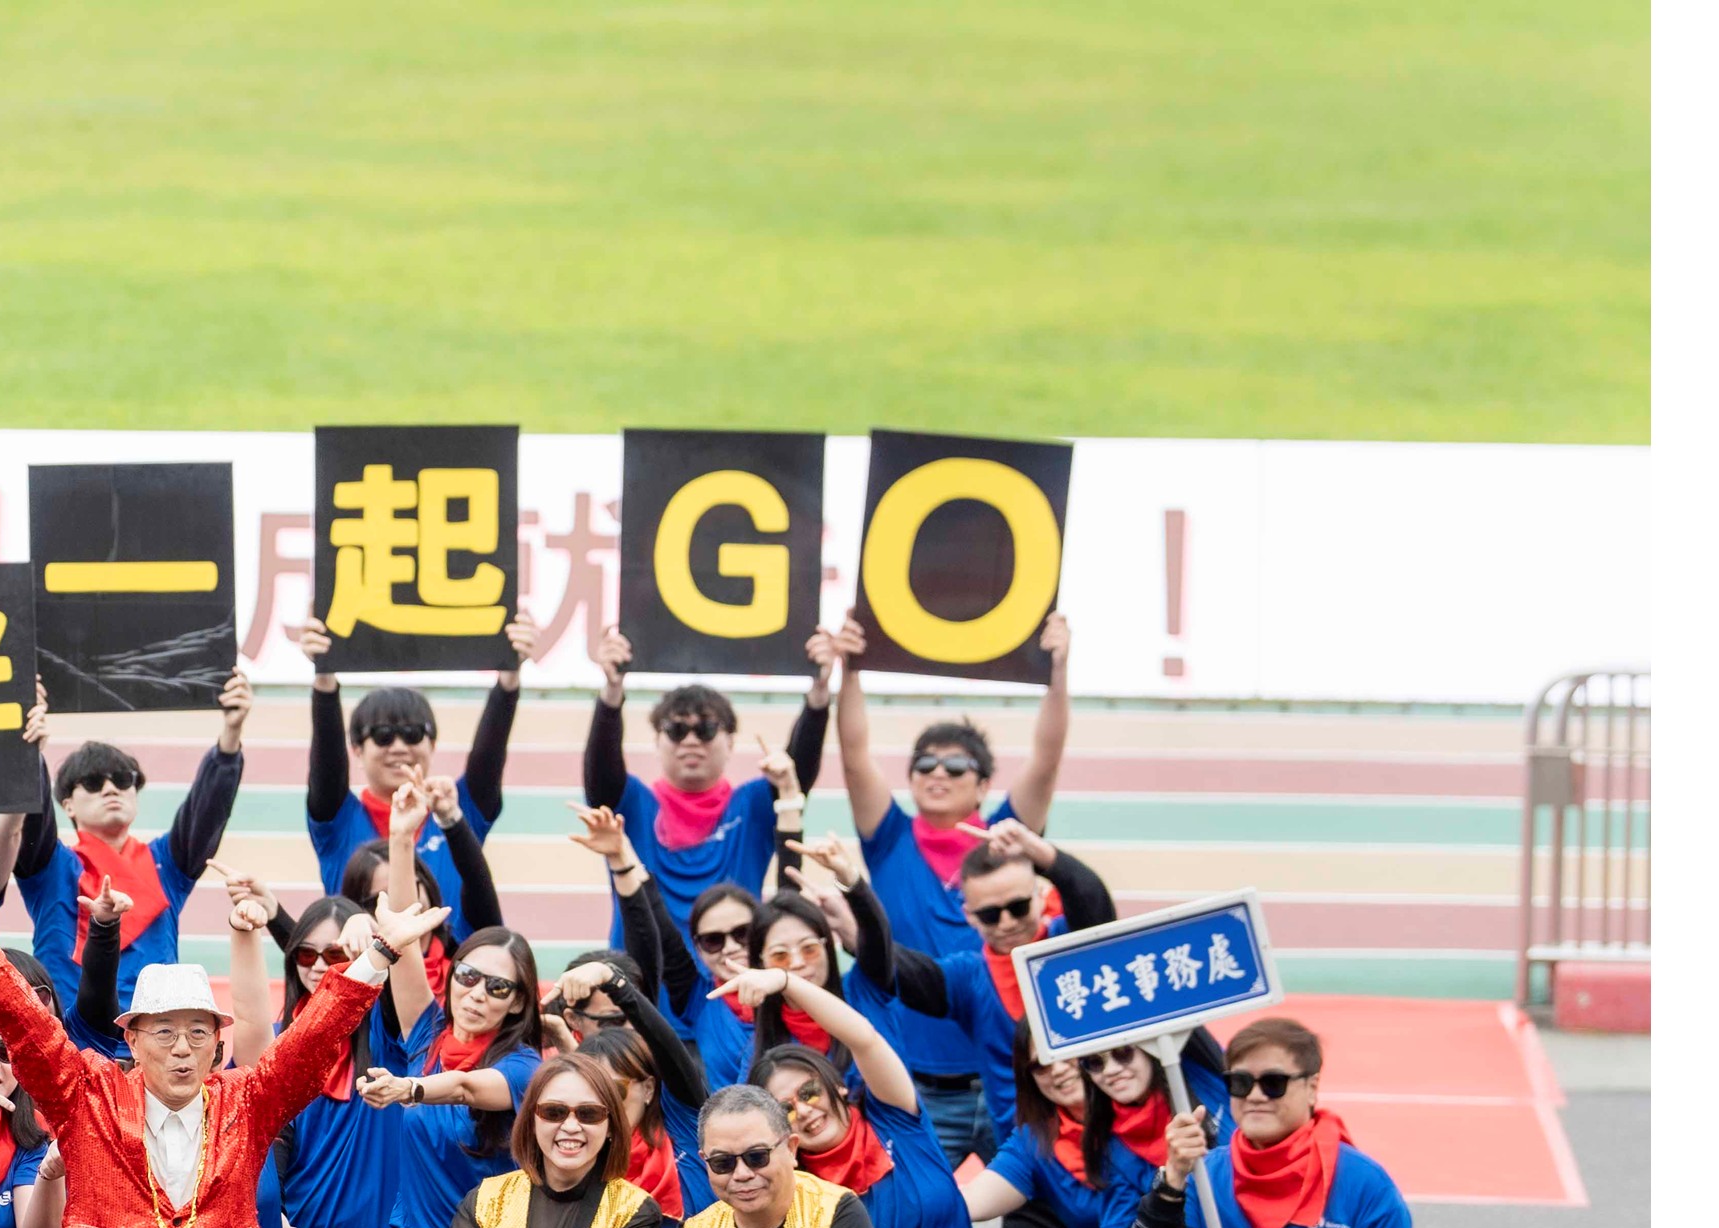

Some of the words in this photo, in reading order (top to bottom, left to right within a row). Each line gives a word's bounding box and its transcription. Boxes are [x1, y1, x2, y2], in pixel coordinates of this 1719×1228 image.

[325, 464, 507, 638] 起
[654, 470, 791, 639] G
[863, 457, 1061, 664] O
[1054, 932, 1246, 1021] 學生事務處
